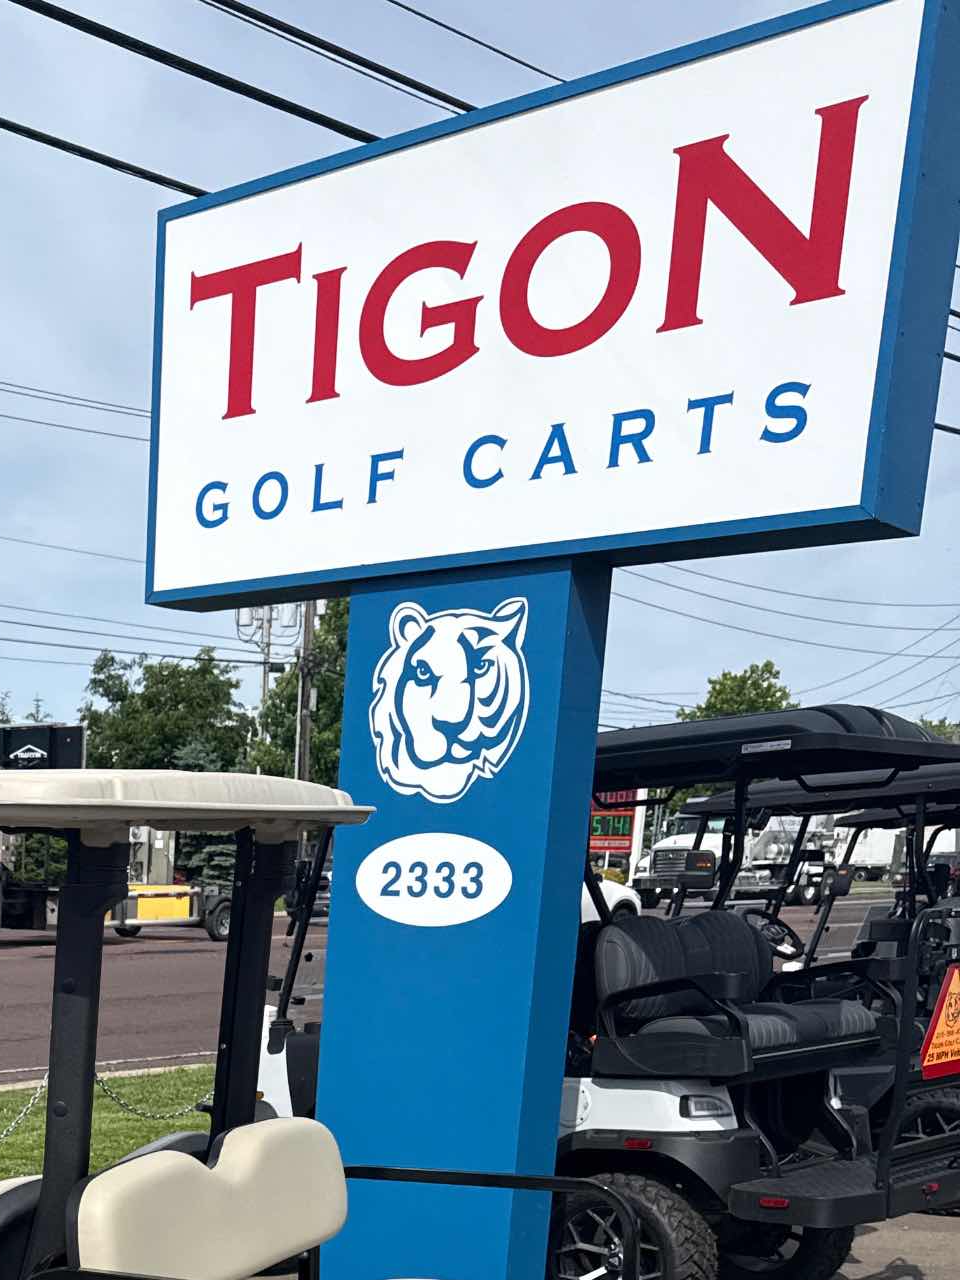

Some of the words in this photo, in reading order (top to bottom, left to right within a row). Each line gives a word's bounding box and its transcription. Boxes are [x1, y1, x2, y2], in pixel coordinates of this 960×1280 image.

[190, 95, 869, 420] TIGON
[196, 448, 404, 529] GOLF
[463, 381, 812, 489] CARTS
[380, 861, 484, 899] 2333
